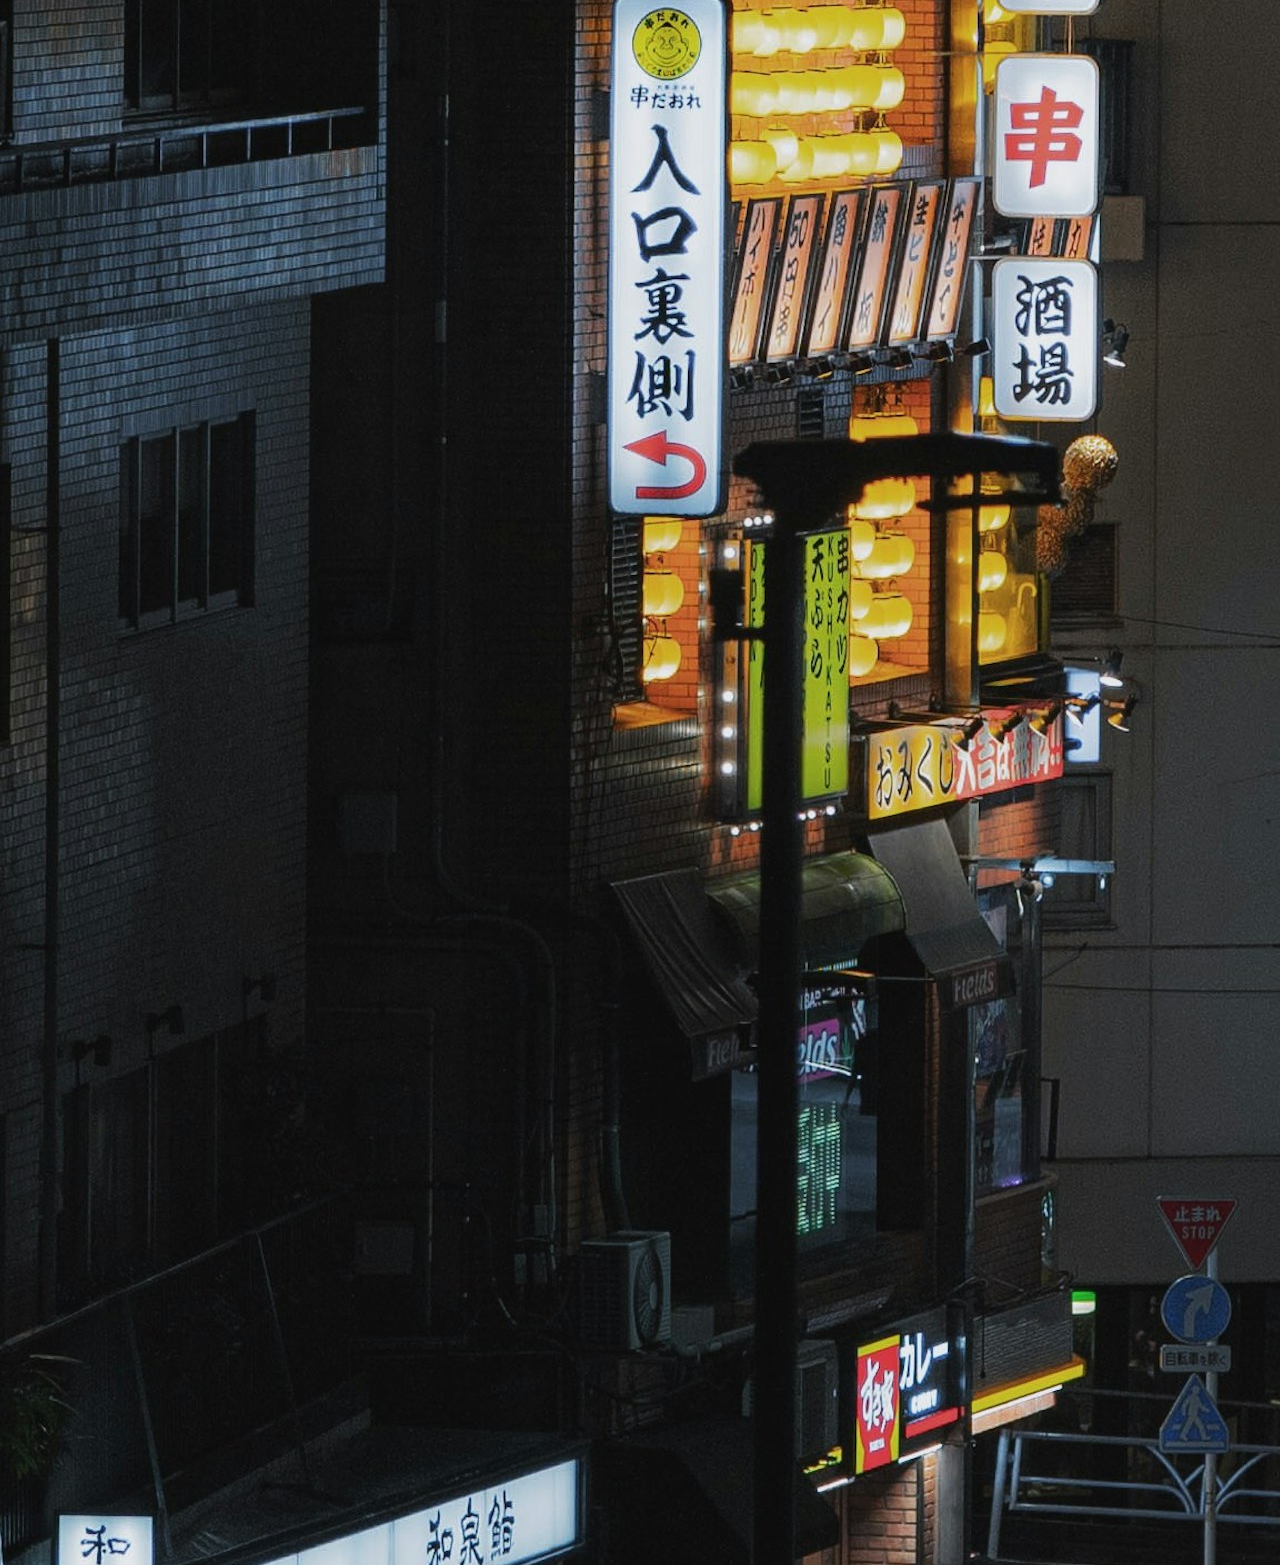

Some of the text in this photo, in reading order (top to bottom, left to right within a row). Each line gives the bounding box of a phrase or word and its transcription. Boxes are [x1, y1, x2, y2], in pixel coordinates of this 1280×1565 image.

[631, 84, 701, 110] 串だおれ
[1004, 86, 1084, 189] 串
[626, 123, 702, 422] 入口裏側
[731, 206, 766, 354] ハイボール
[895, 196, 930, 334] 生ビール
[1012, 275, 1074, 405] 酒場
[811, 538, 825, 678] 天ぷら
[837, 534, 849, 674] 串カツ
[825, 536, 834, 789] KUSHIKATSU
[953, 968, 995, 1003] Fields
[799, 1028, 838, 1075] elds
[1174, 1205, 1222, 1222] 止まれ
[1181, 1225, 1216, 1240] STOP
[899, 1332, 949, 1390] カレー
